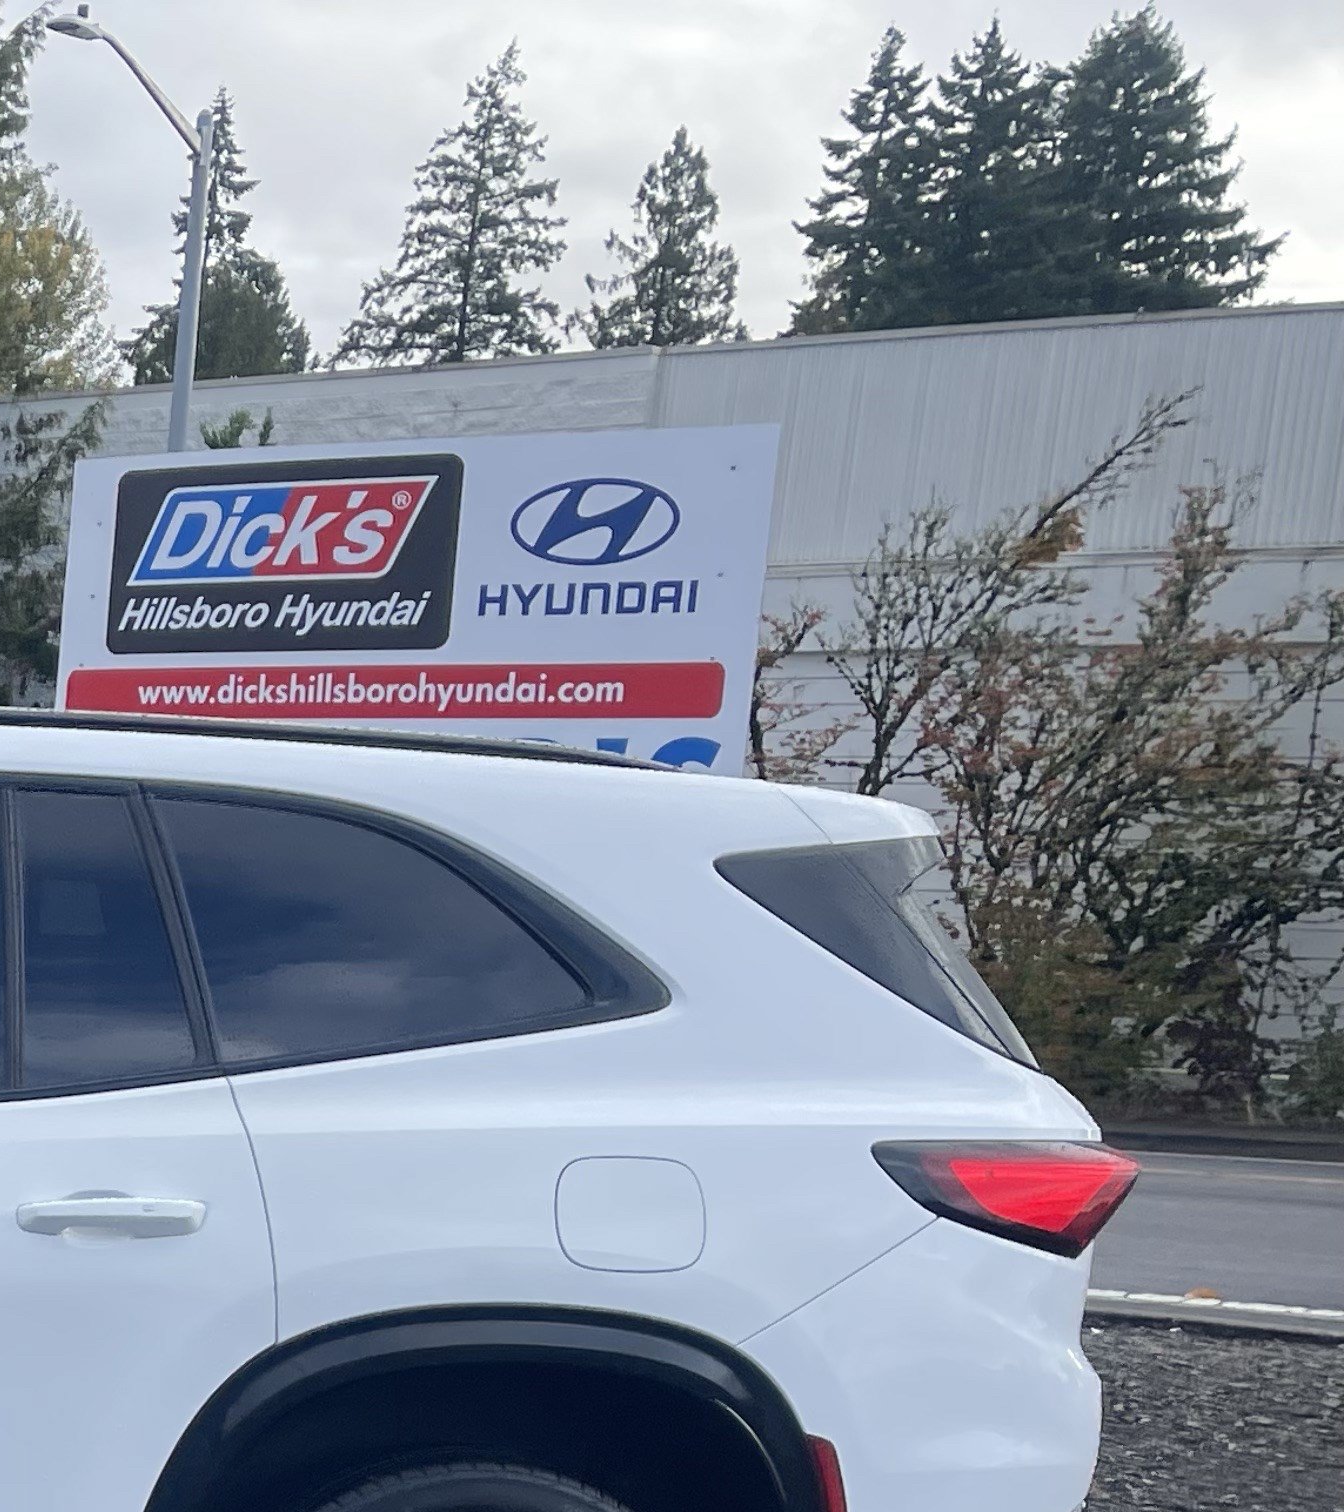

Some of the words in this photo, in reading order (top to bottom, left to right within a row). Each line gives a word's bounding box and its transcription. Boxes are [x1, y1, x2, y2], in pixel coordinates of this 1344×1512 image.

[117, 595, 271, 632] Hillsboro
[273, 590, 432, 637] Hyundai
[477, 579, 700, 617] HYUNDAI
[137, 671, 625, 712] www.dickshillsborohyundai.com
